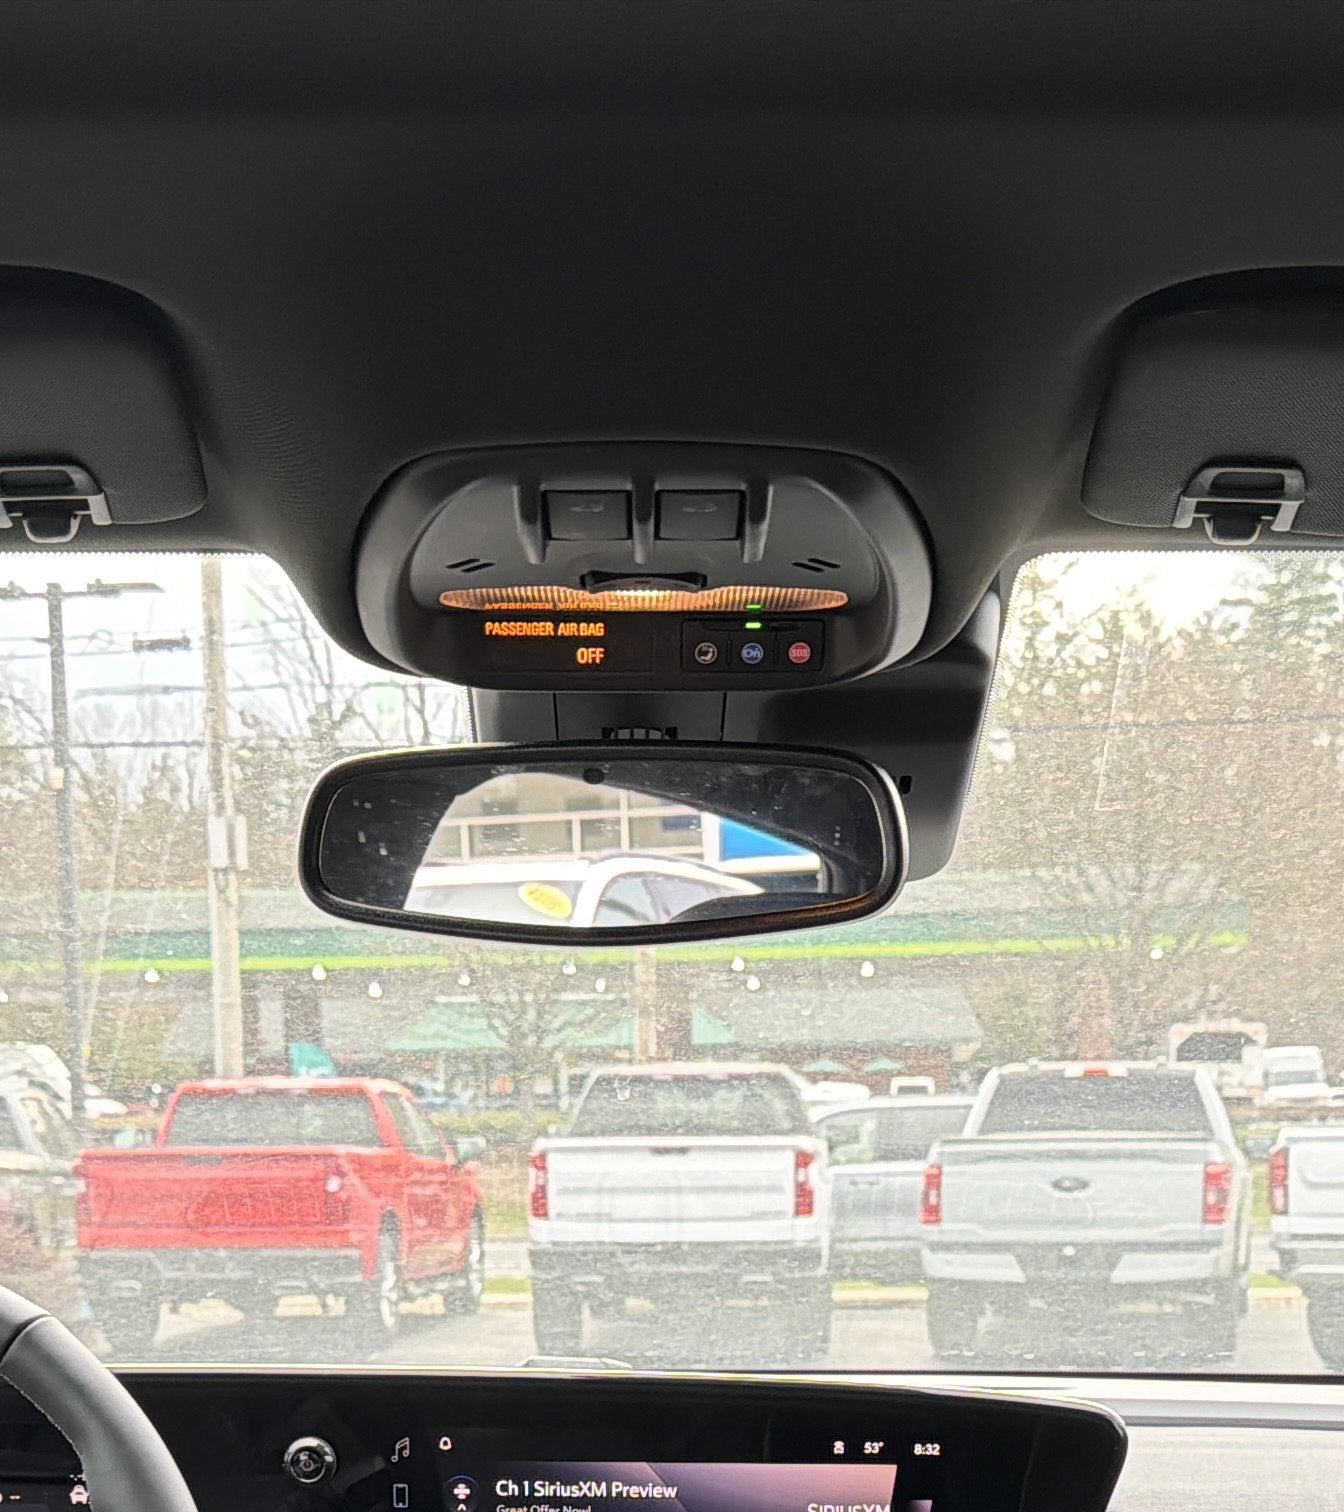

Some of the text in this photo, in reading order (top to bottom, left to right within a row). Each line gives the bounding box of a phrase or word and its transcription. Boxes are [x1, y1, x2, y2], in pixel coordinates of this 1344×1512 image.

[485, 621, 605, 636] PASSENGER AIR BAG
[576, 647, 605, 664] OFF
[790, 648, 808, 657] SOS
[913, 1443, 941, 1456] 8:32
[495, 1480, 678, 1498] Ch 1 SiriusXM Preview
